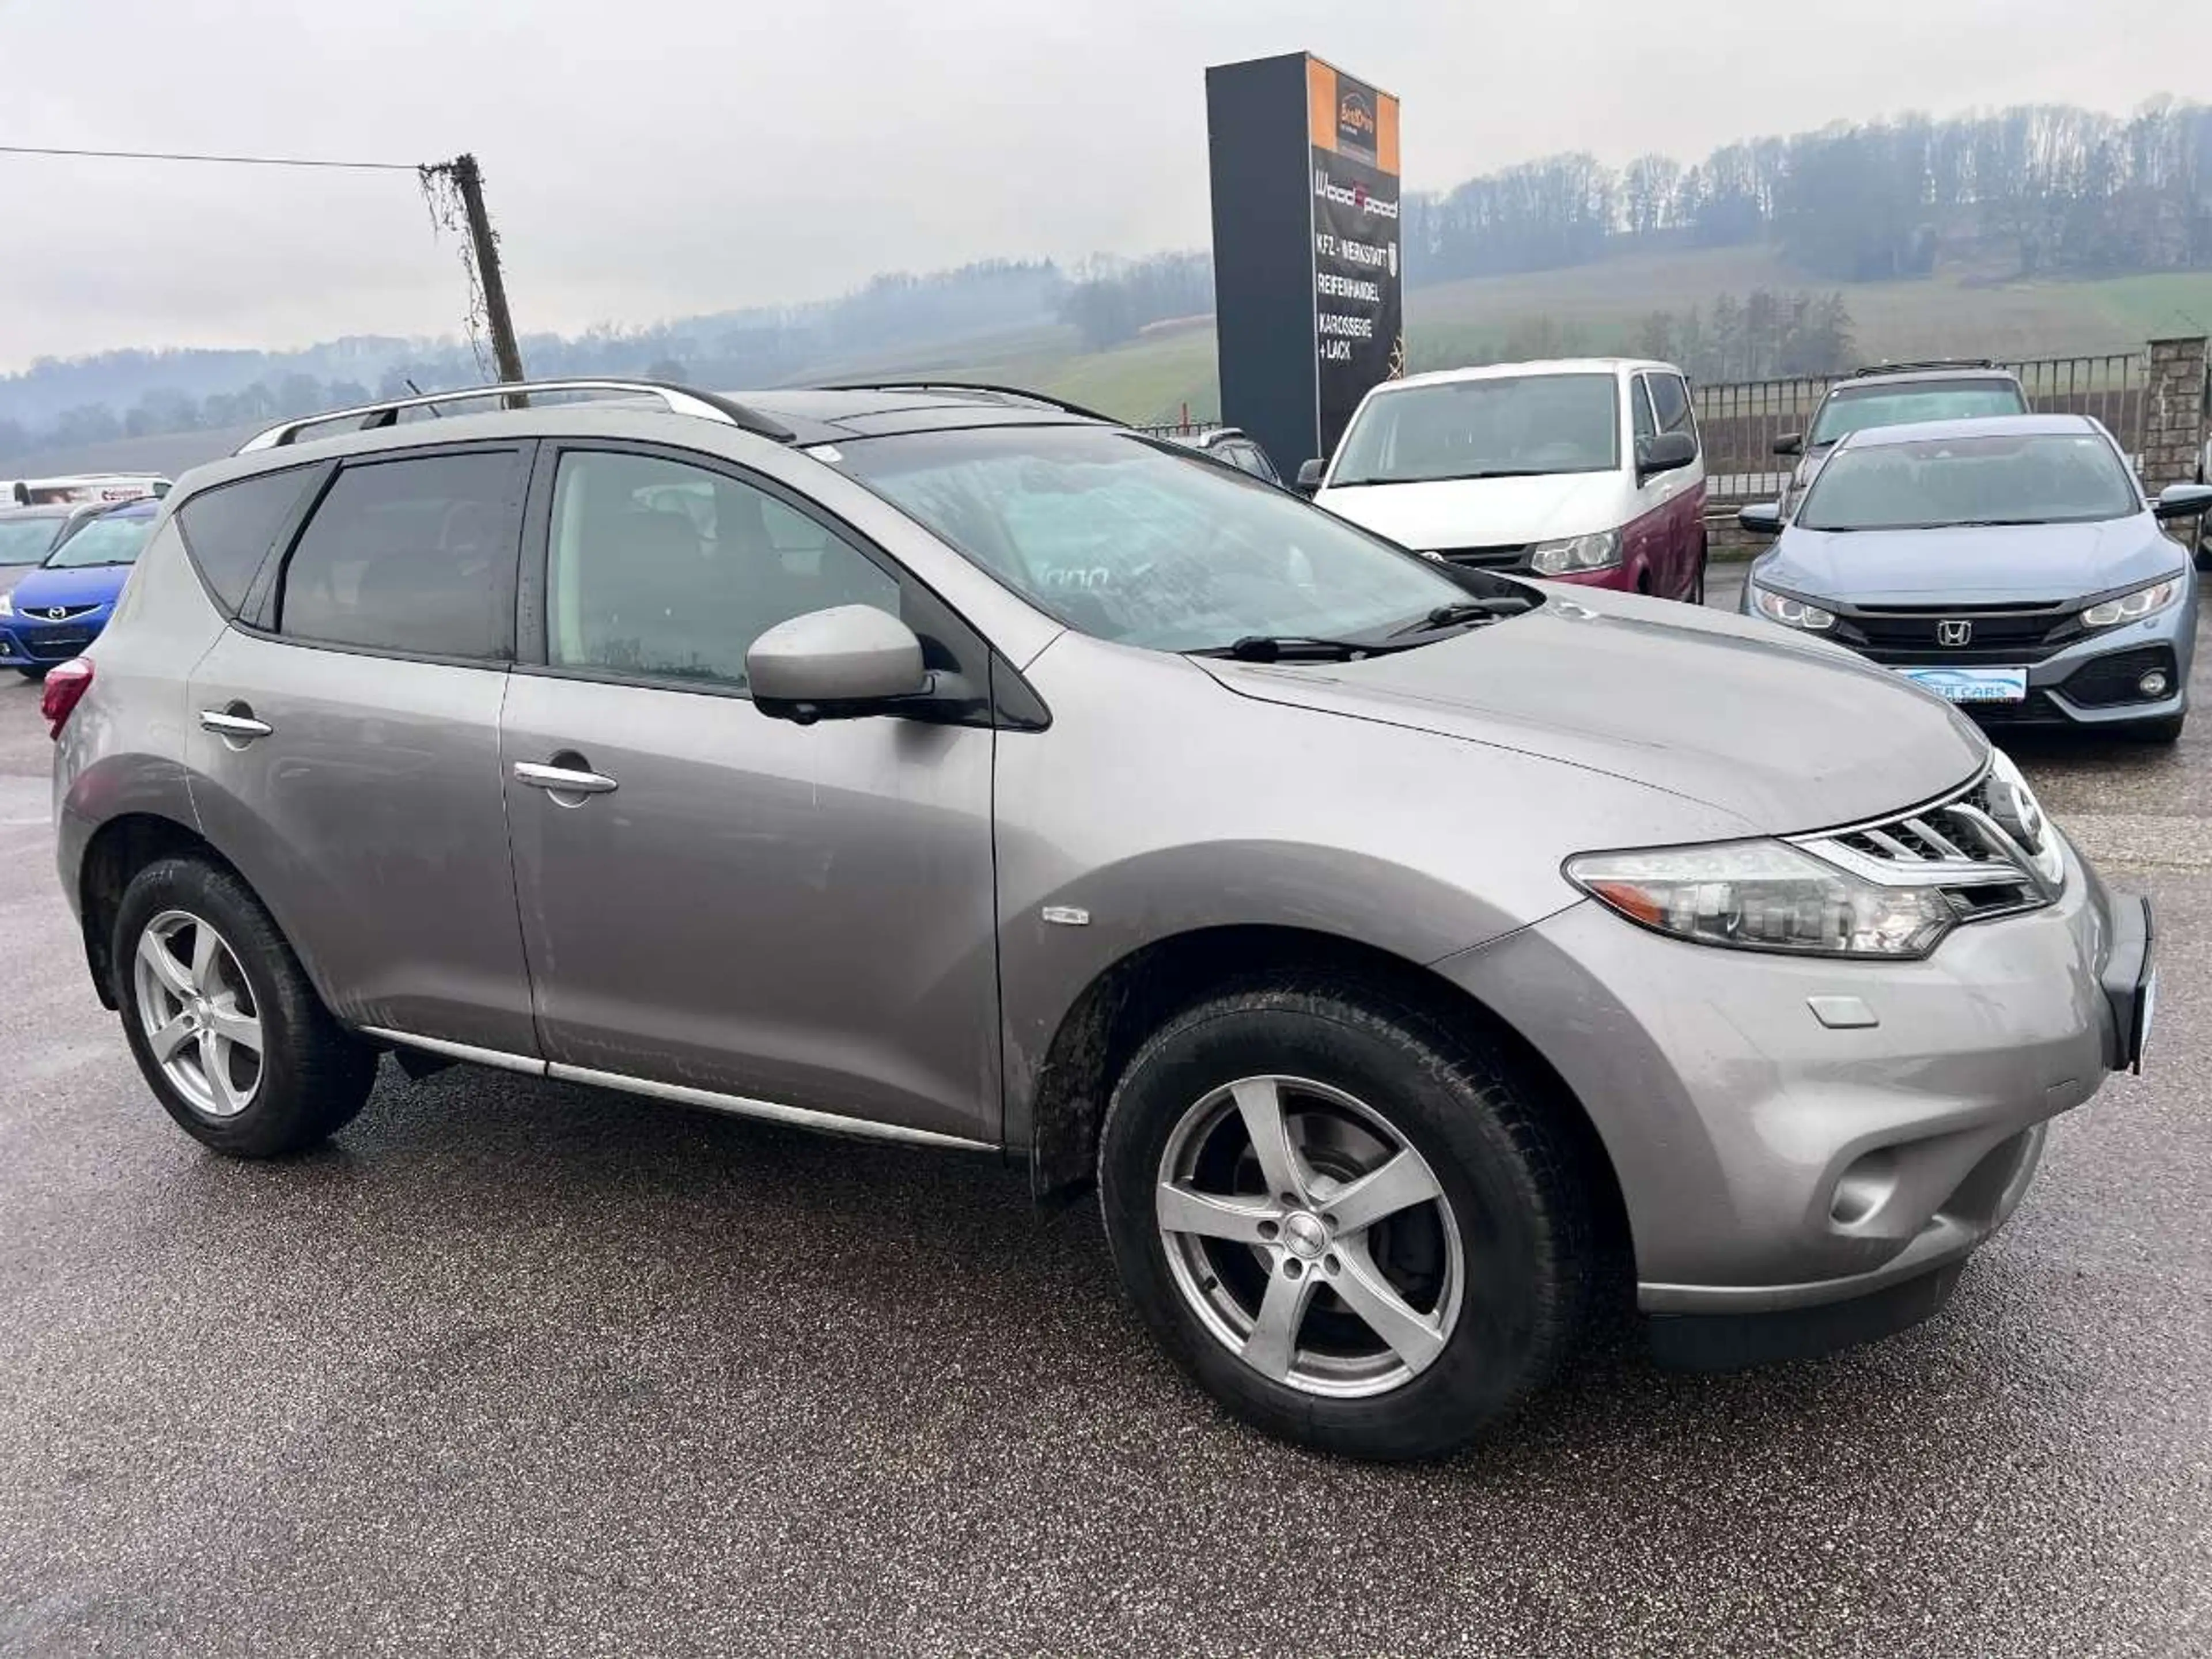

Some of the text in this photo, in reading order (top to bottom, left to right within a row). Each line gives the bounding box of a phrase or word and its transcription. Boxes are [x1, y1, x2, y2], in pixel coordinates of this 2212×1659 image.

[1317, 272, 1380, 301] REIFENHANDEL
[1320, 313, 1372, 338] KAROSSERIE
[1327, 339, 1351, 360] LACK
